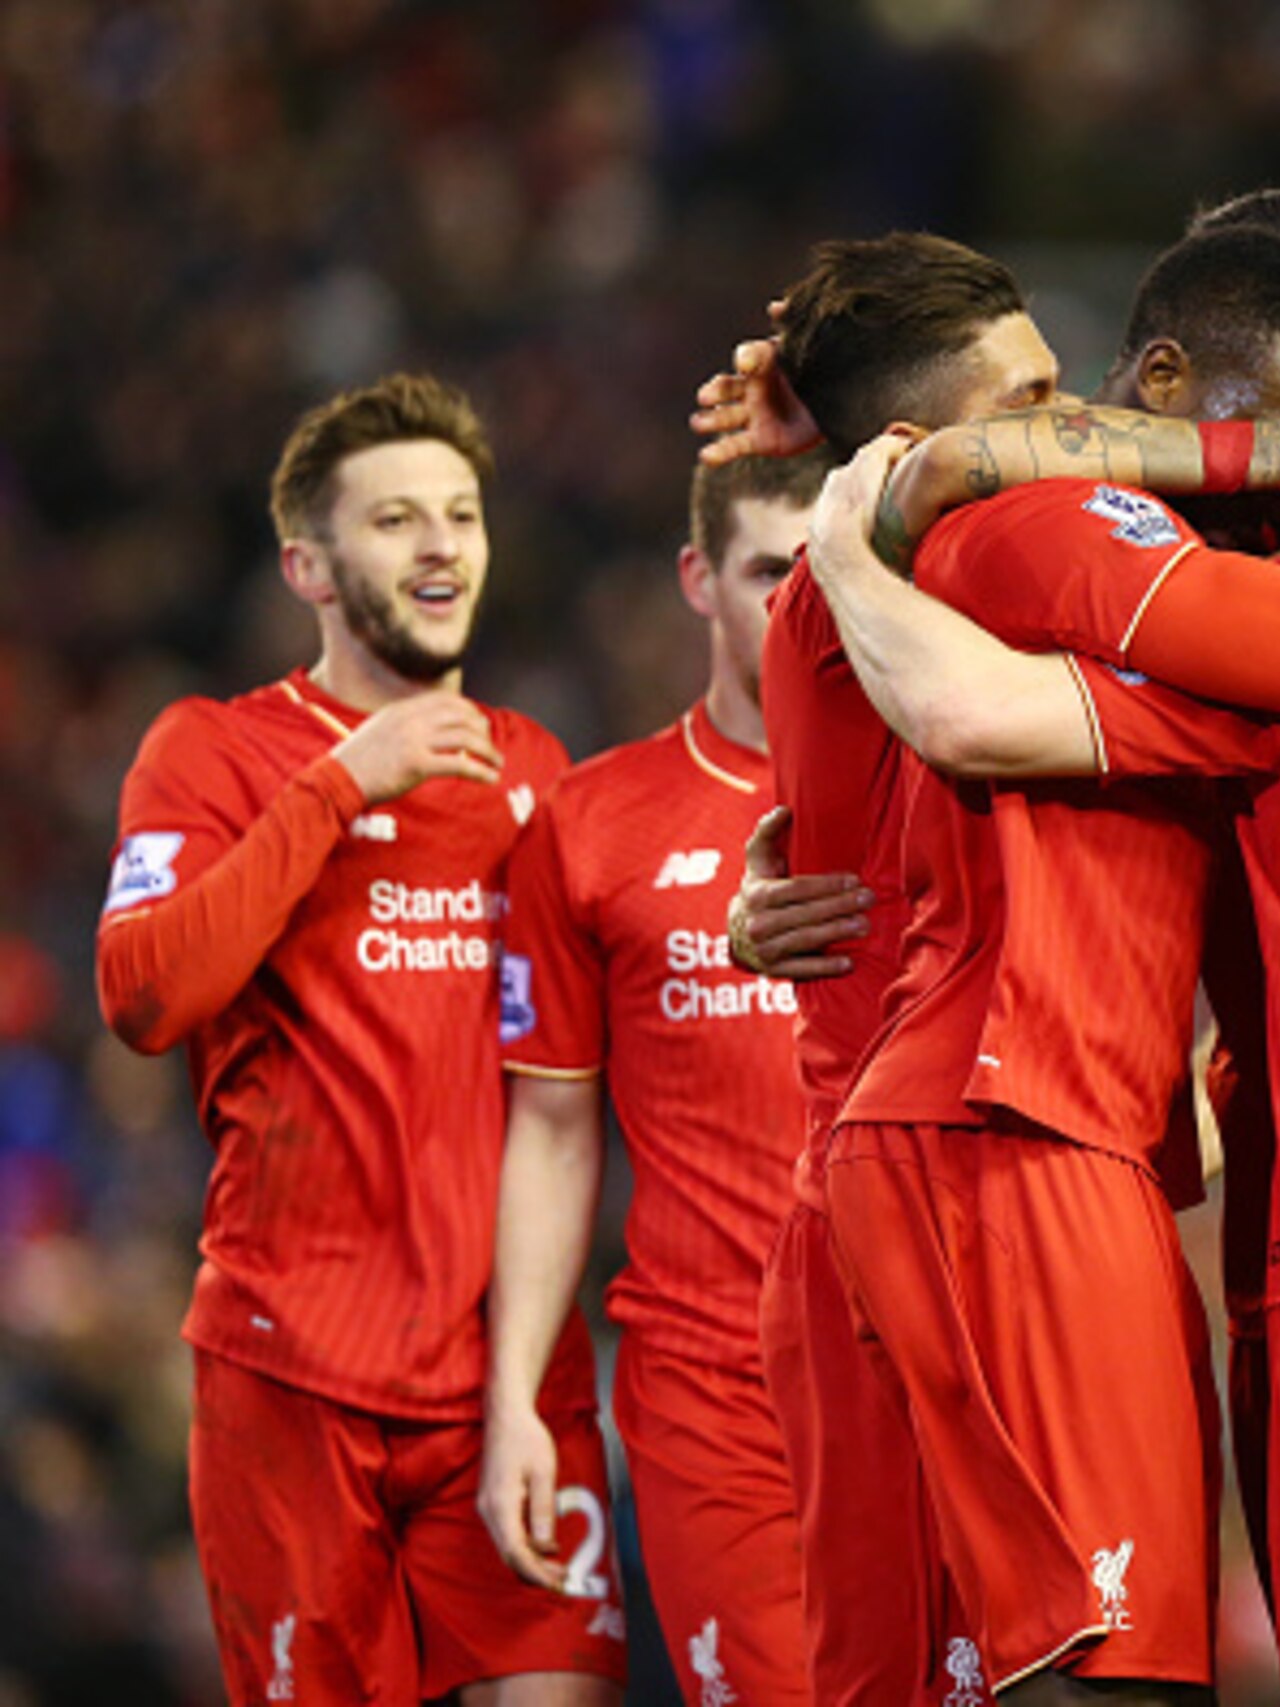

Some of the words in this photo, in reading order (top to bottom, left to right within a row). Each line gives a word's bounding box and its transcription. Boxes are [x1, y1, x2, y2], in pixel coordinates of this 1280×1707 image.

[369, 878, 505, 922] Stand
[357, 924, 494, 973] Charte
[555, 1484, 608, 1600] 2
